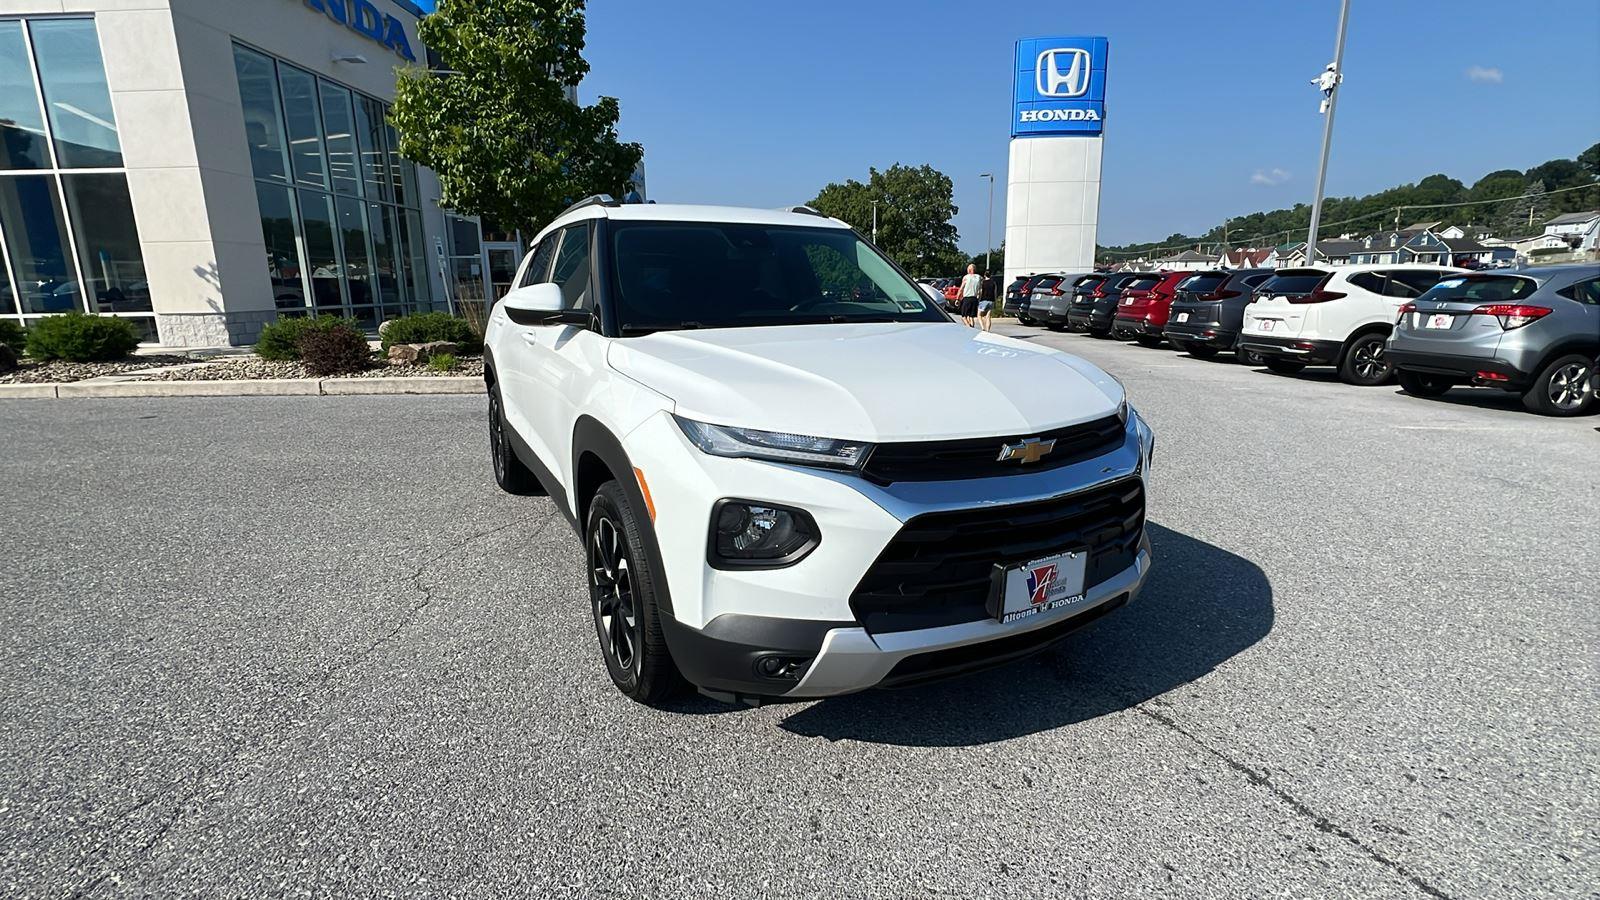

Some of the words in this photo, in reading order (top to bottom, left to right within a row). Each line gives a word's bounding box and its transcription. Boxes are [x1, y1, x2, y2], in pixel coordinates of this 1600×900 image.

[1020, 109, 1101, 122] HONDA
[1003, 607, 1038, 624] Altoona
[1051, 594, 1084, 609] HONDA
